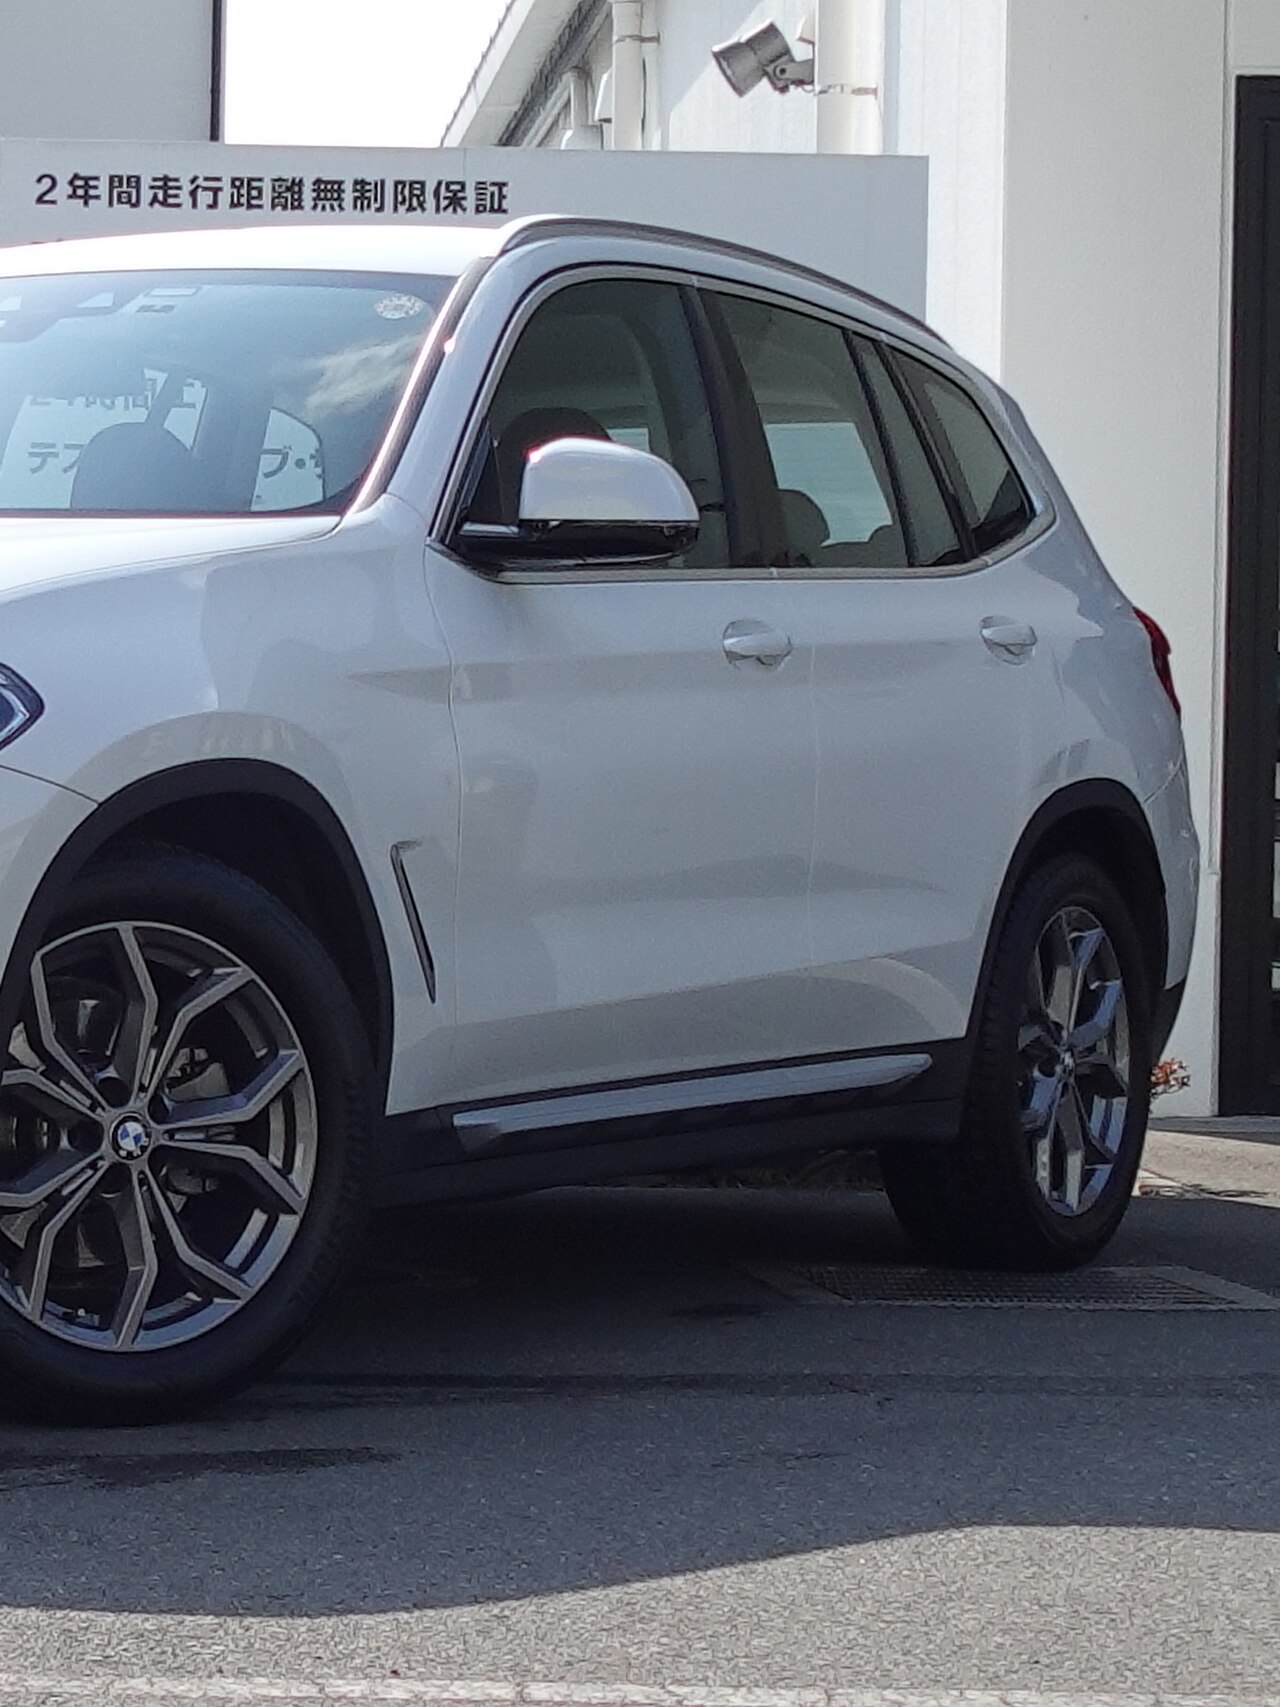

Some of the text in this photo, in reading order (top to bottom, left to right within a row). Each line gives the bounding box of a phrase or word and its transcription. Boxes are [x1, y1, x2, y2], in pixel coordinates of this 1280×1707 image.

[34, 171, 510, 215] 2年間走行距離無制限保証
